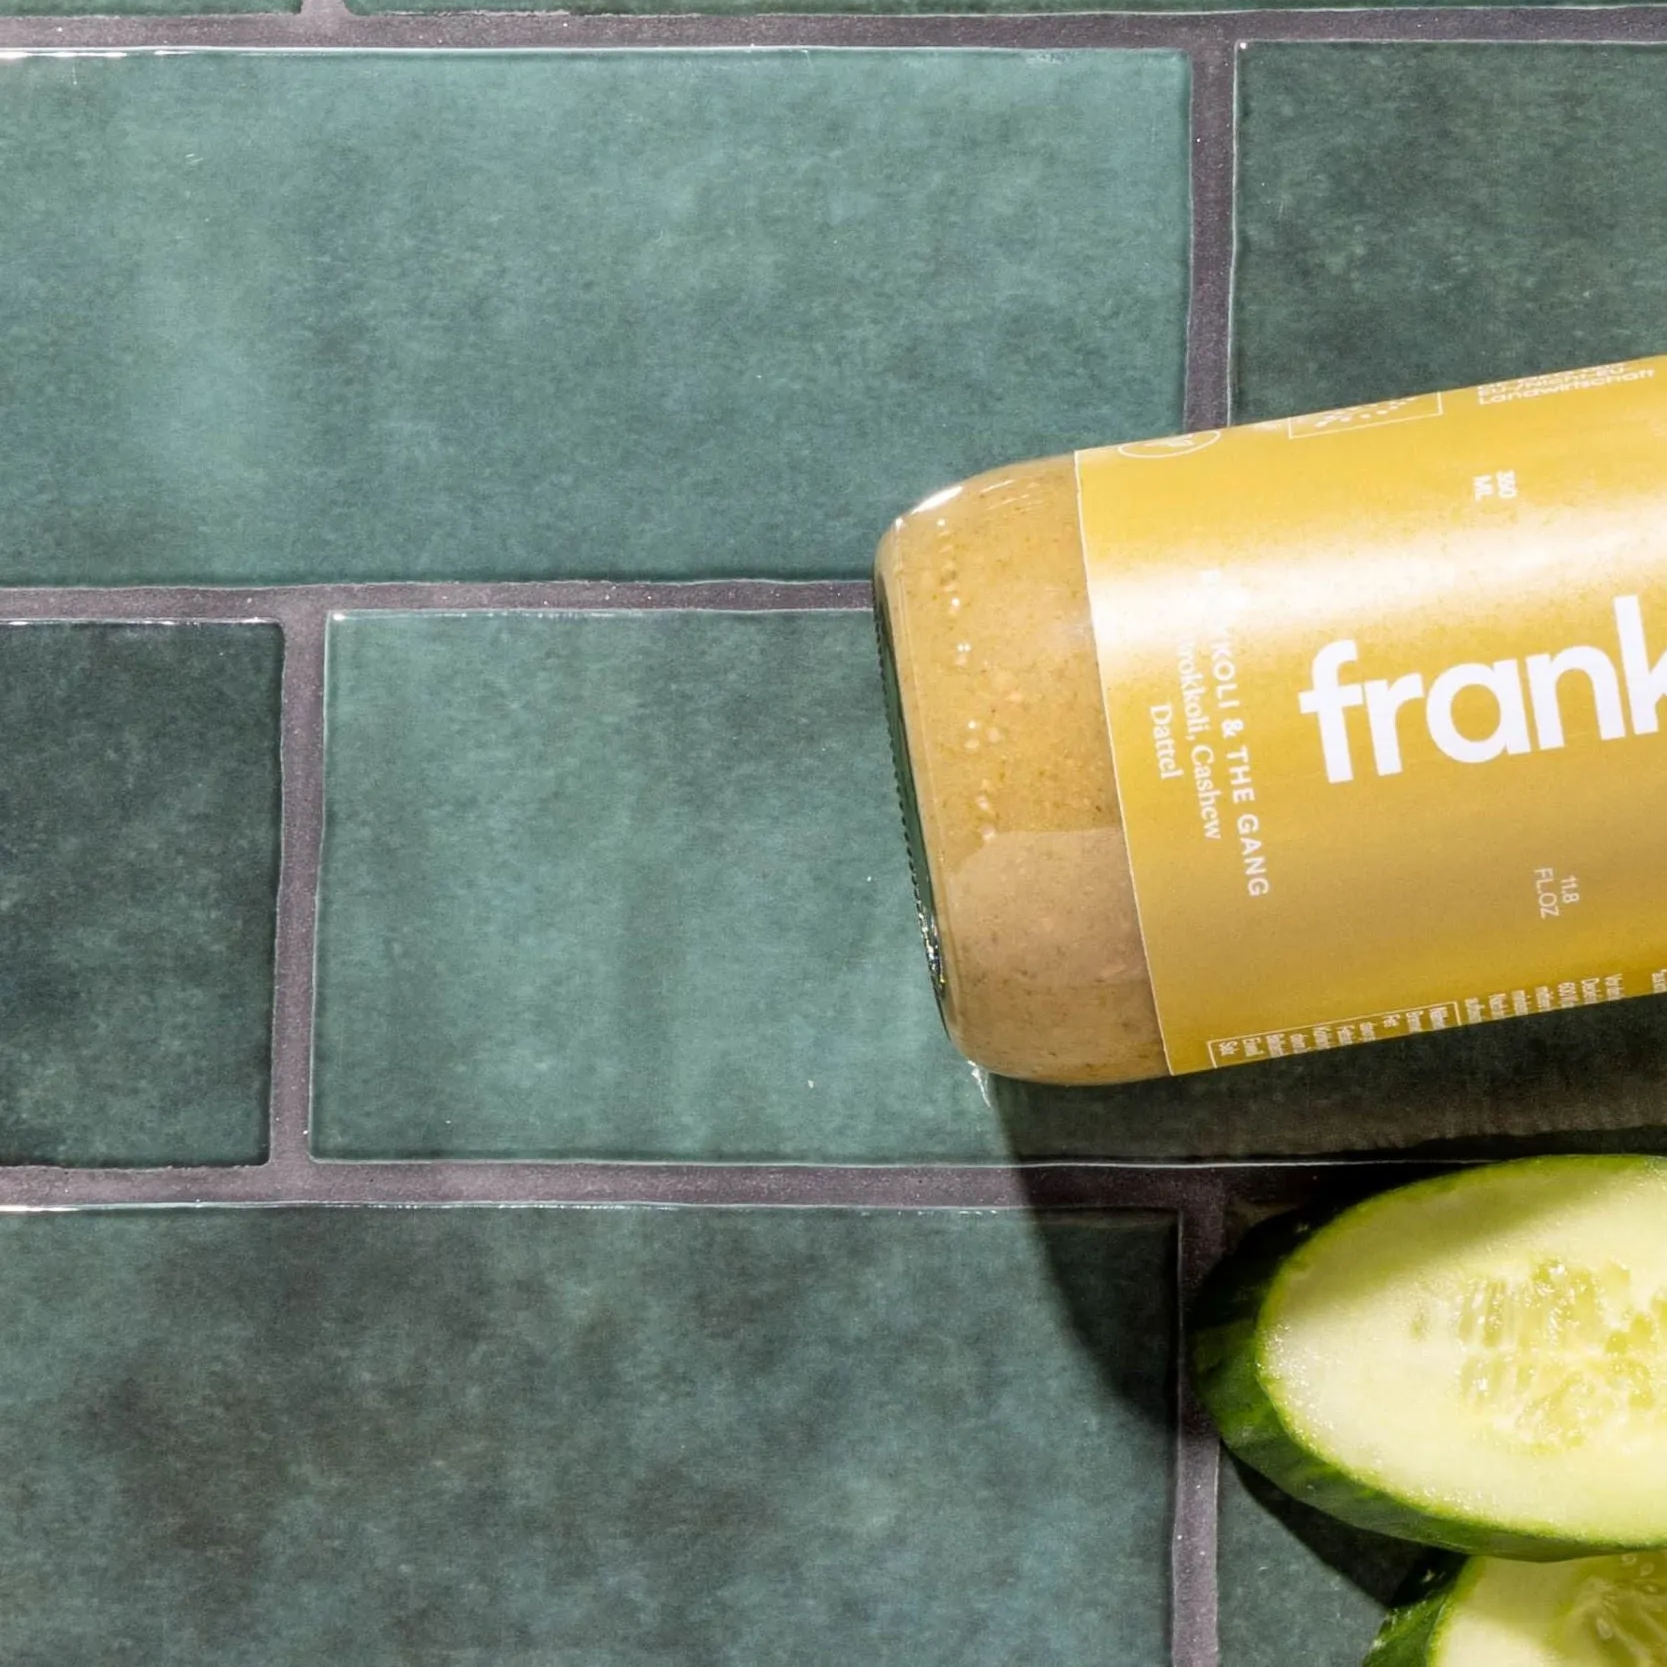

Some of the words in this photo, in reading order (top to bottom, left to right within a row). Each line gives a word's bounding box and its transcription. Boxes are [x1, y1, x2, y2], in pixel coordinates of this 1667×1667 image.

[1147, 701, 1184, 781] Dattel
[1224, 745, 1256, 804] THE
[1188, 742, 1227, 842] Cashew
[1234, 811, 1271, 898] GANG
[1558, 873, 1581, 905] 11.8
